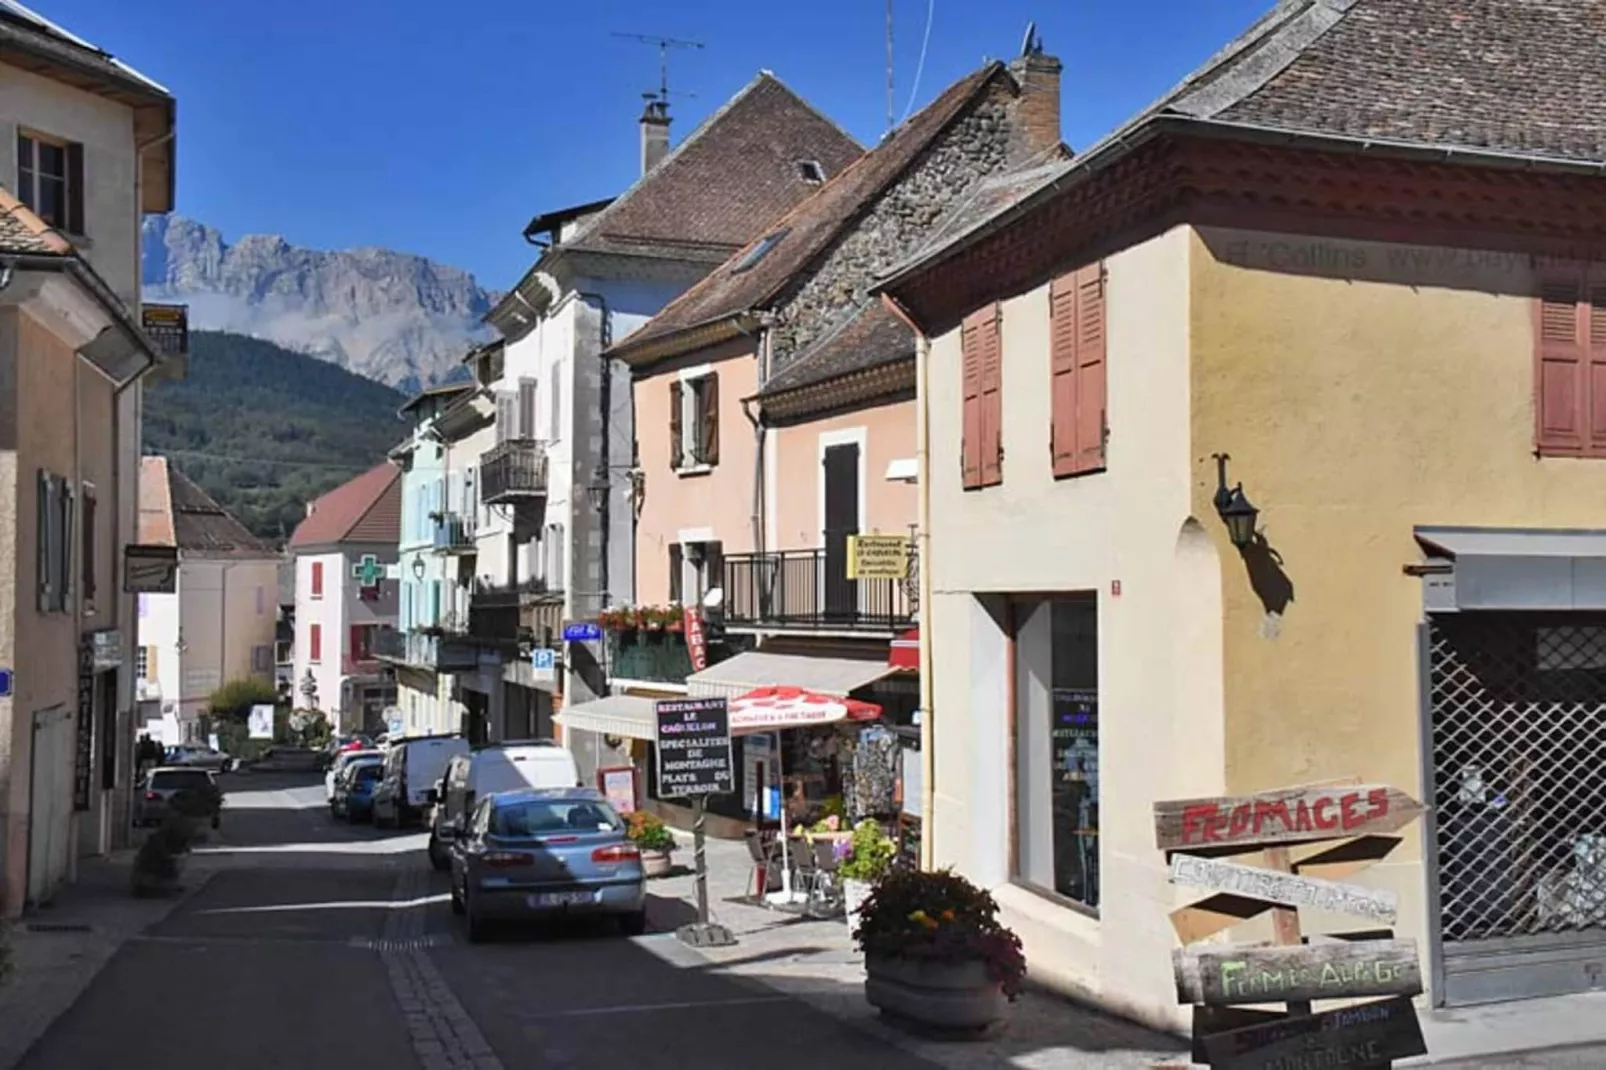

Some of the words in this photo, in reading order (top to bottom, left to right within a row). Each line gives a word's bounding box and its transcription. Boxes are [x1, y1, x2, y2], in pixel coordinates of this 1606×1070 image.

[687, 608, 705, 668] TABAC
[657, 700, 725, 712] RESTAURANT
[684, 712, 697, 721] LE
[687, 749, 703, 758] DE
[664, 758, 727, 771] MONTAGNE
[662, 773, 697, 784] PLATS
[1182, 790, 1388, 841] FROMAGES
